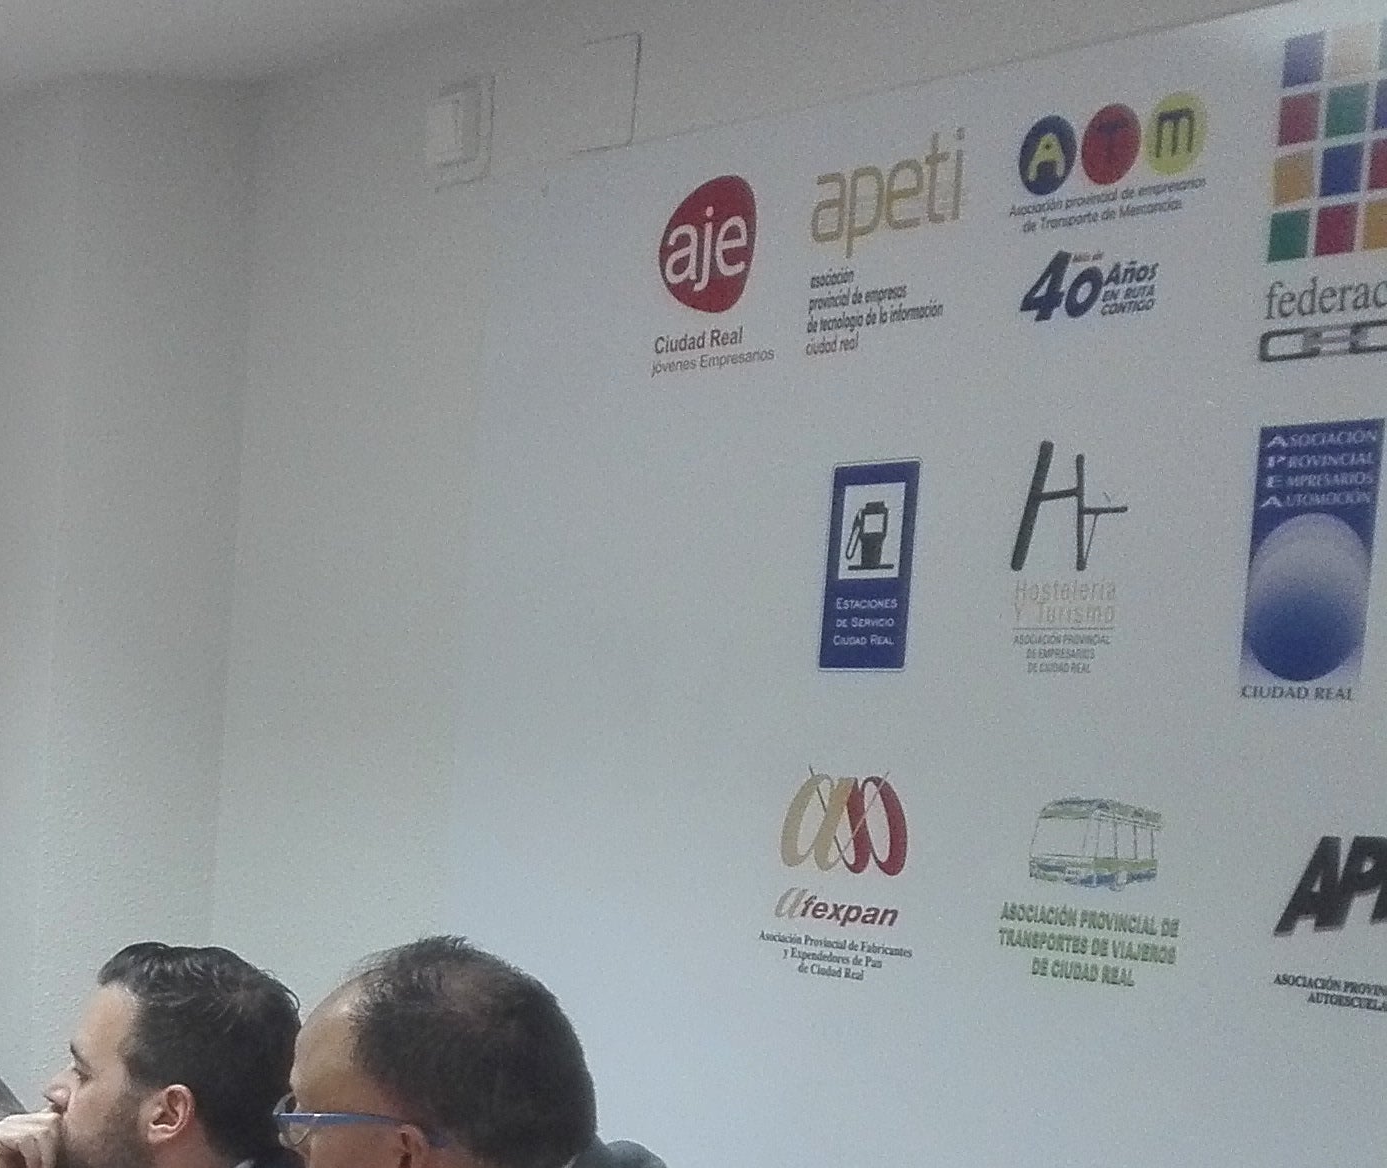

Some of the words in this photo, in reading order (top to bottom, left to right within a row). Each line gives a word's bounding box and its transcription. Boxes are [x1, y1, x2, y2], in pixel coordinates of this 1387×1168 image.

[810, 127, 966, 259] apeti
[665, 206, 748, 292] aje
[1019, 249, 1104, 322] 40
[1264, 276, 1387, 320] federac
[654, 329, 706, 354] Ciudad
[710, 326, 744, 347] Real
[1240, 685, 1309, 700] CIUDAD
[1314, 687, 1354, 701] REAL
[1274, 836, 1387, 937] AP
